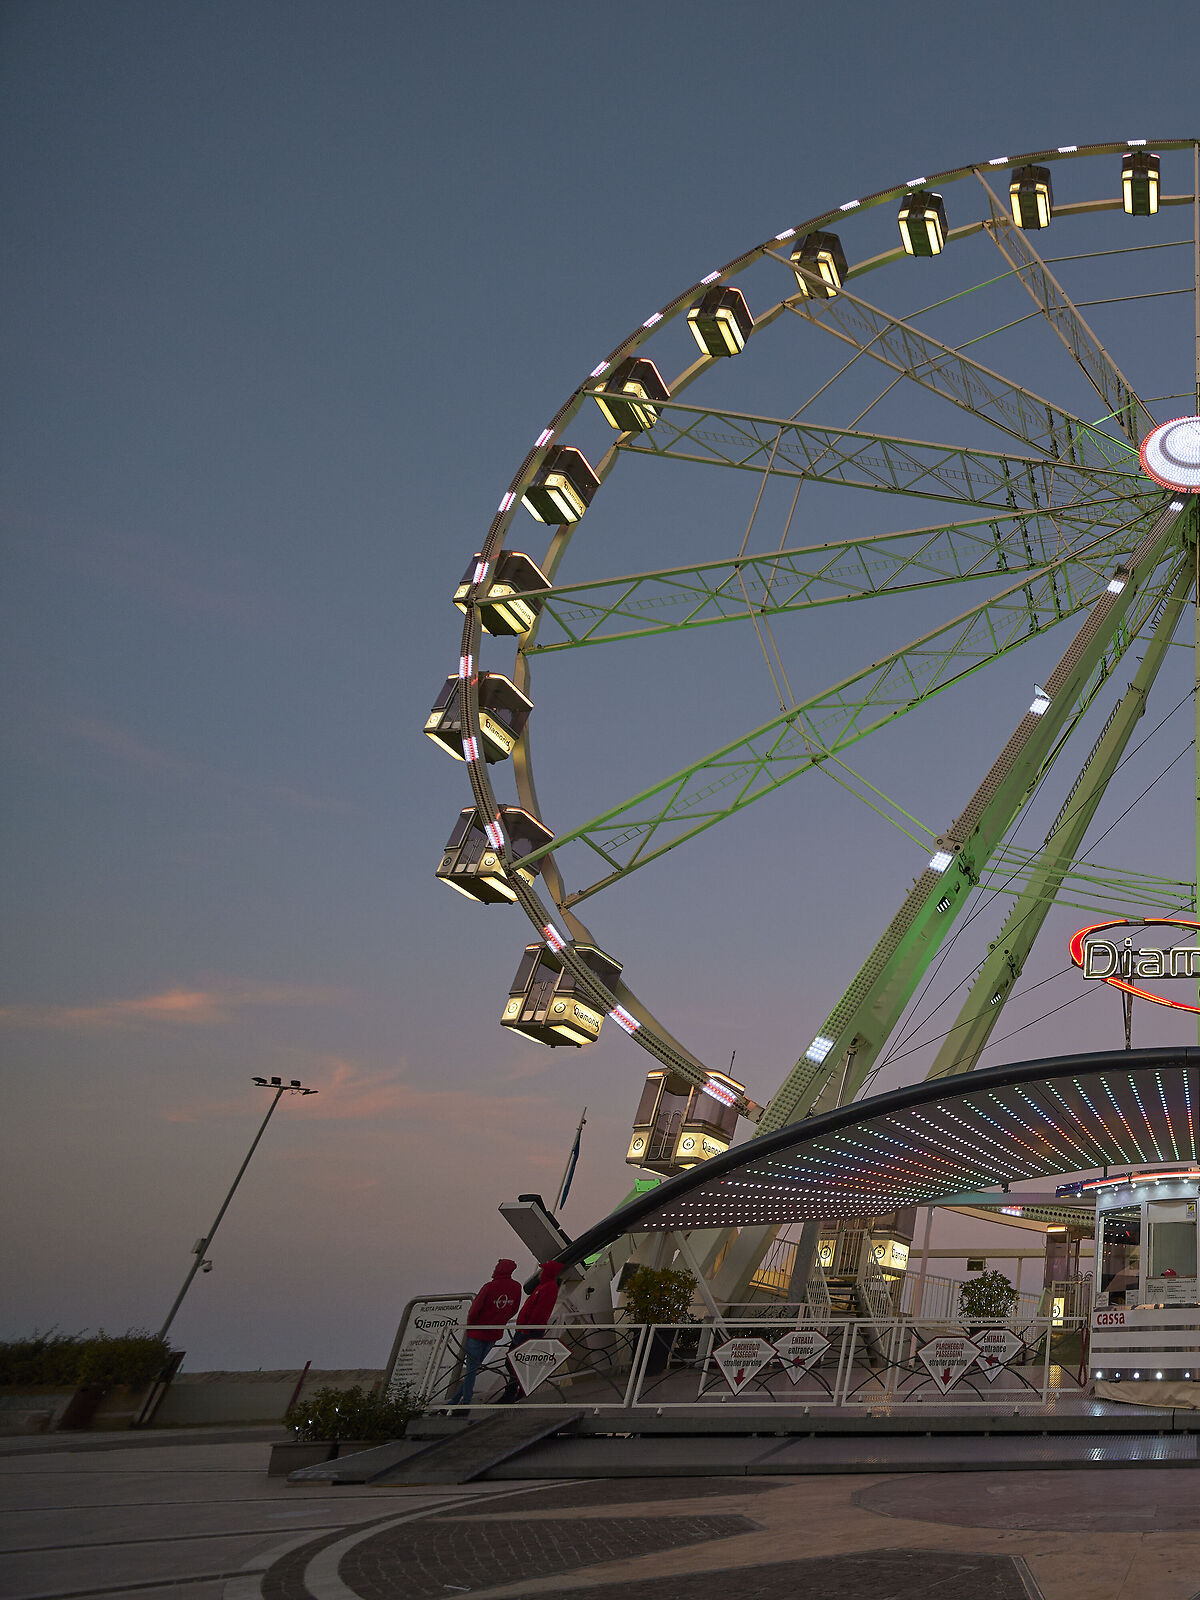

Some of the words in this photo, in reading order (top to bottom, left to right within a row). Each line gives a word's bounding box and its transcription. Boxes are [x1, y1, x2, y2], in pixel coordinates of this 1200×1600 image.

[1097, 1312, 1125, 1325] cassa
[416, 1317, 459, 1329] Diamond
[791, 1336, 814, 1344] ENTRATA
[788, 1346, 814, 1354] entrance
[982, 1345, 1007, 1353] entrance
[516, 1352, 555, 1362] Diamond
[730, 1350, 758, 1358] PASSEGGINI
[935, 1350, 963, 1358] PASSEGGINI
[723, 1359, 742, 1367] stroller
[742, 1359, 762, 1367] parking
[948, 1358, 967, 1367] parking
